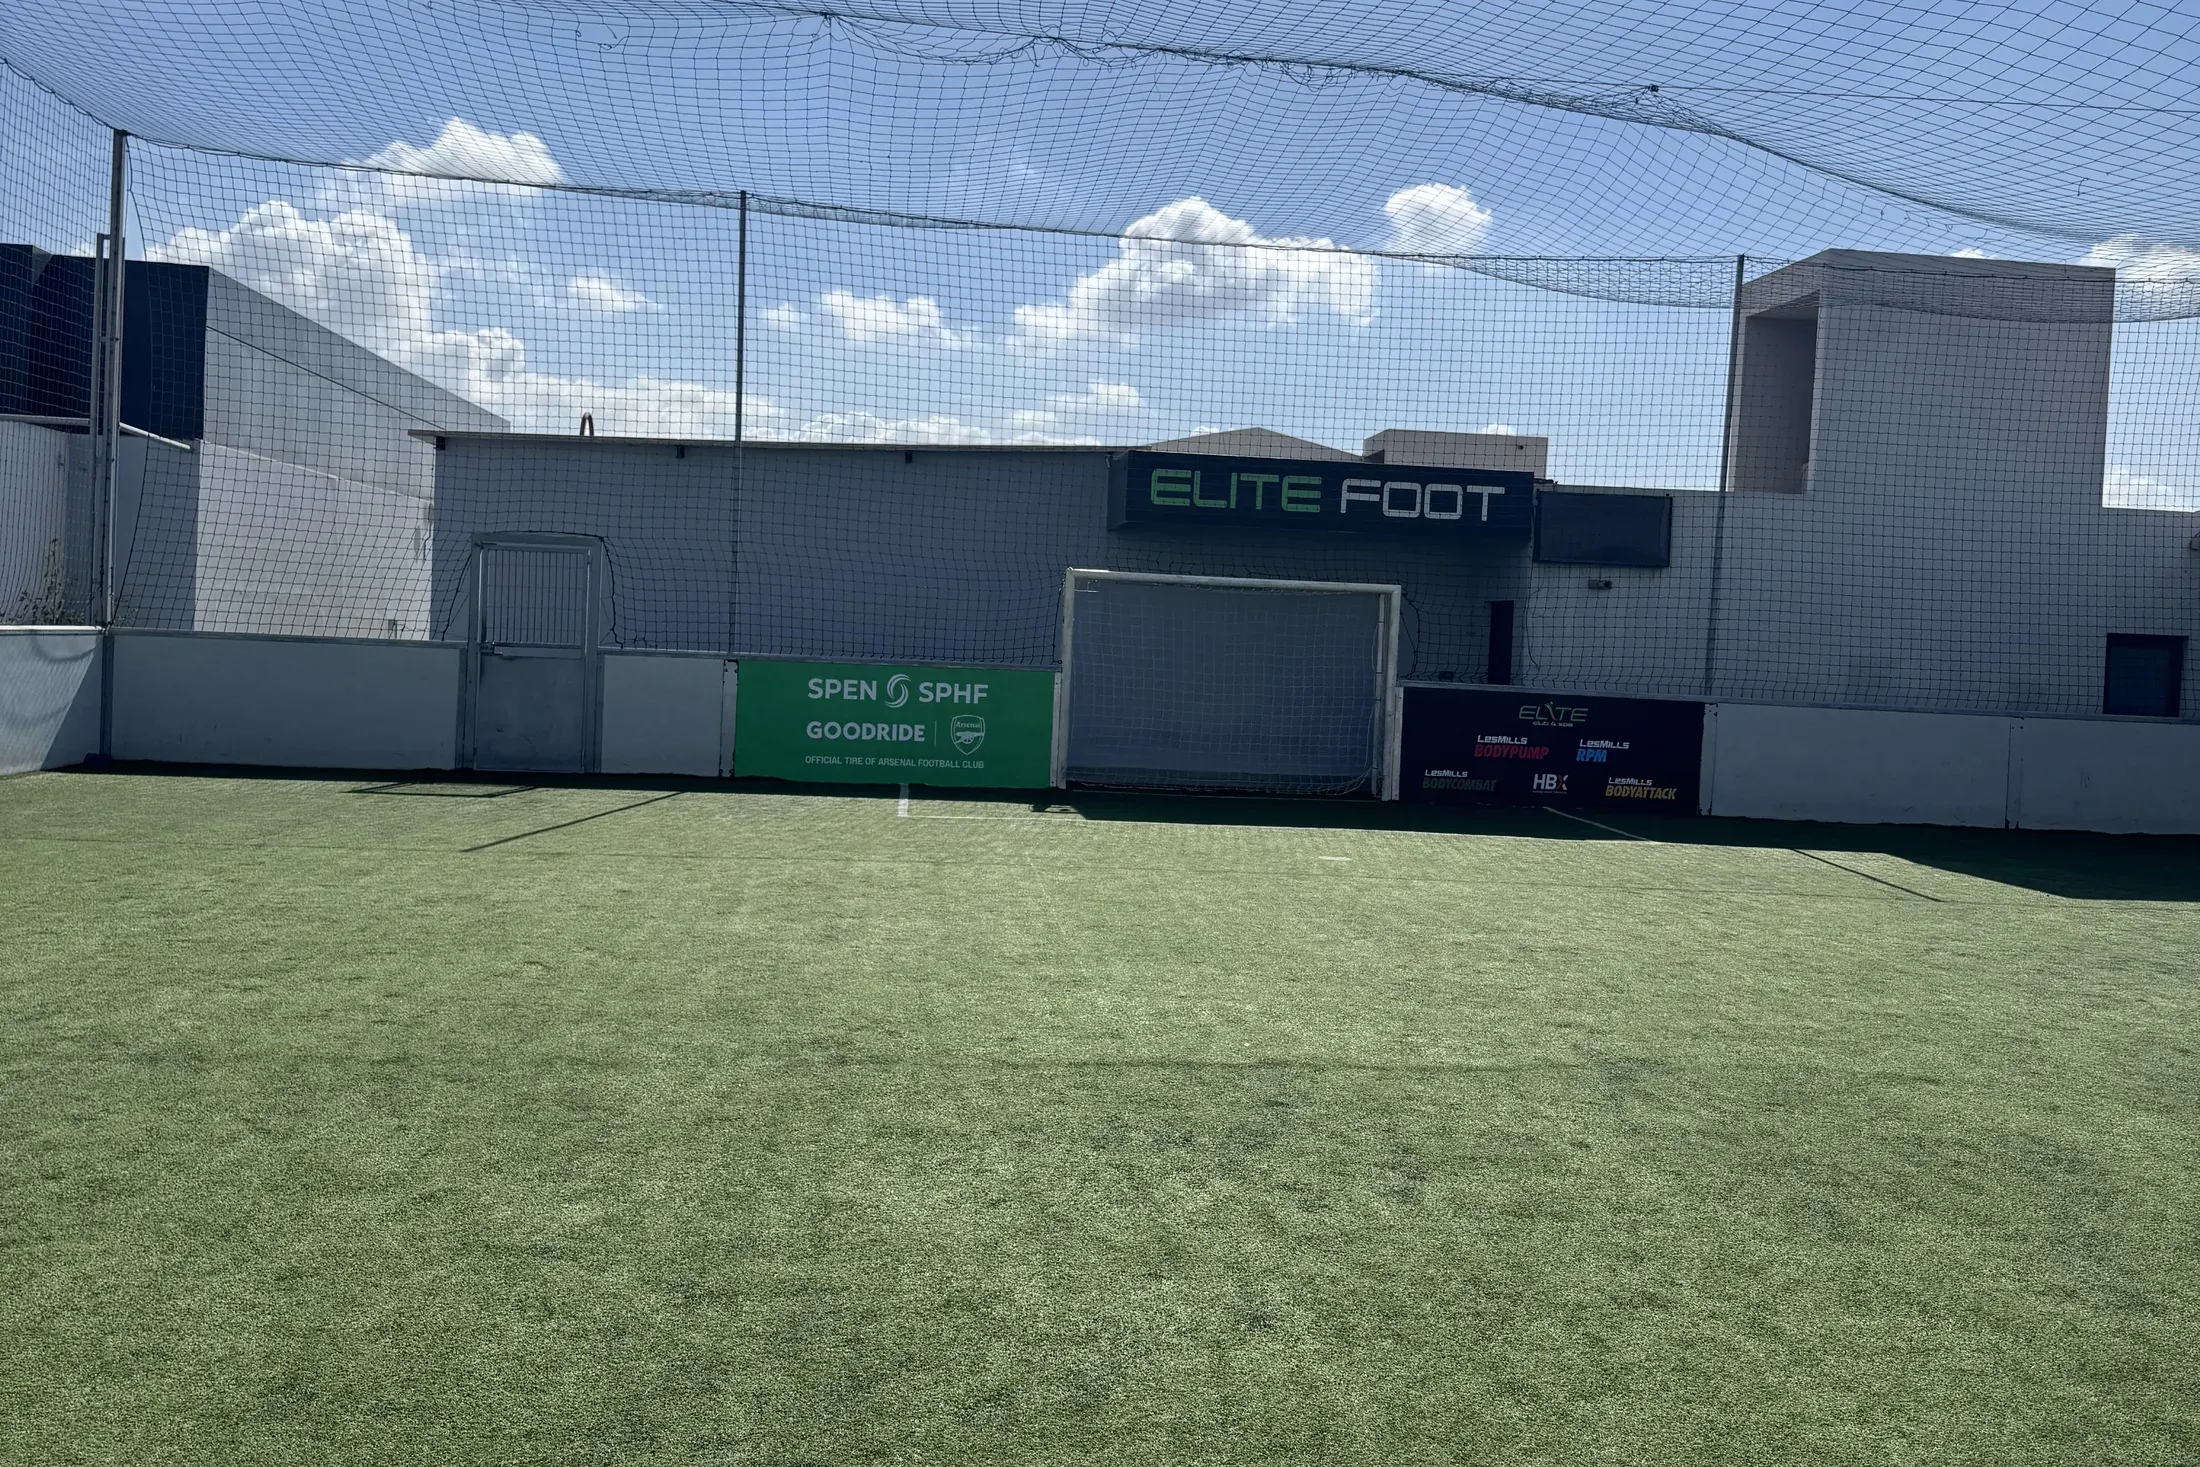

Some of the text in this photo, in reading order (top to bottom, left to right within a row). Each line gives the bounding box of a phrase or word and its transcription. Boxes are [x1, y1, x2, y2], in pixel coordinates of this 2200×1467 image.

[1150, 468, 1505, 521] ELITE FOOT
[807, 678, 989, 704] SPEN SPHF
[806, 721, 926, 742] GOODRIDE
[1473, 744, 1550, 760] BODYPUMP
[1576, 748, 1607, 762] RPM
[805, 756, 984, 769] OFFICIAL TIRE OF ARSENAL FOOTBALL CLUB
[1422, 777, 1497, 791] BODYCOMBAT
[1532, 774, 1569, 790] HBX
[1605, 785, 1678, 800] BODYATTACK
